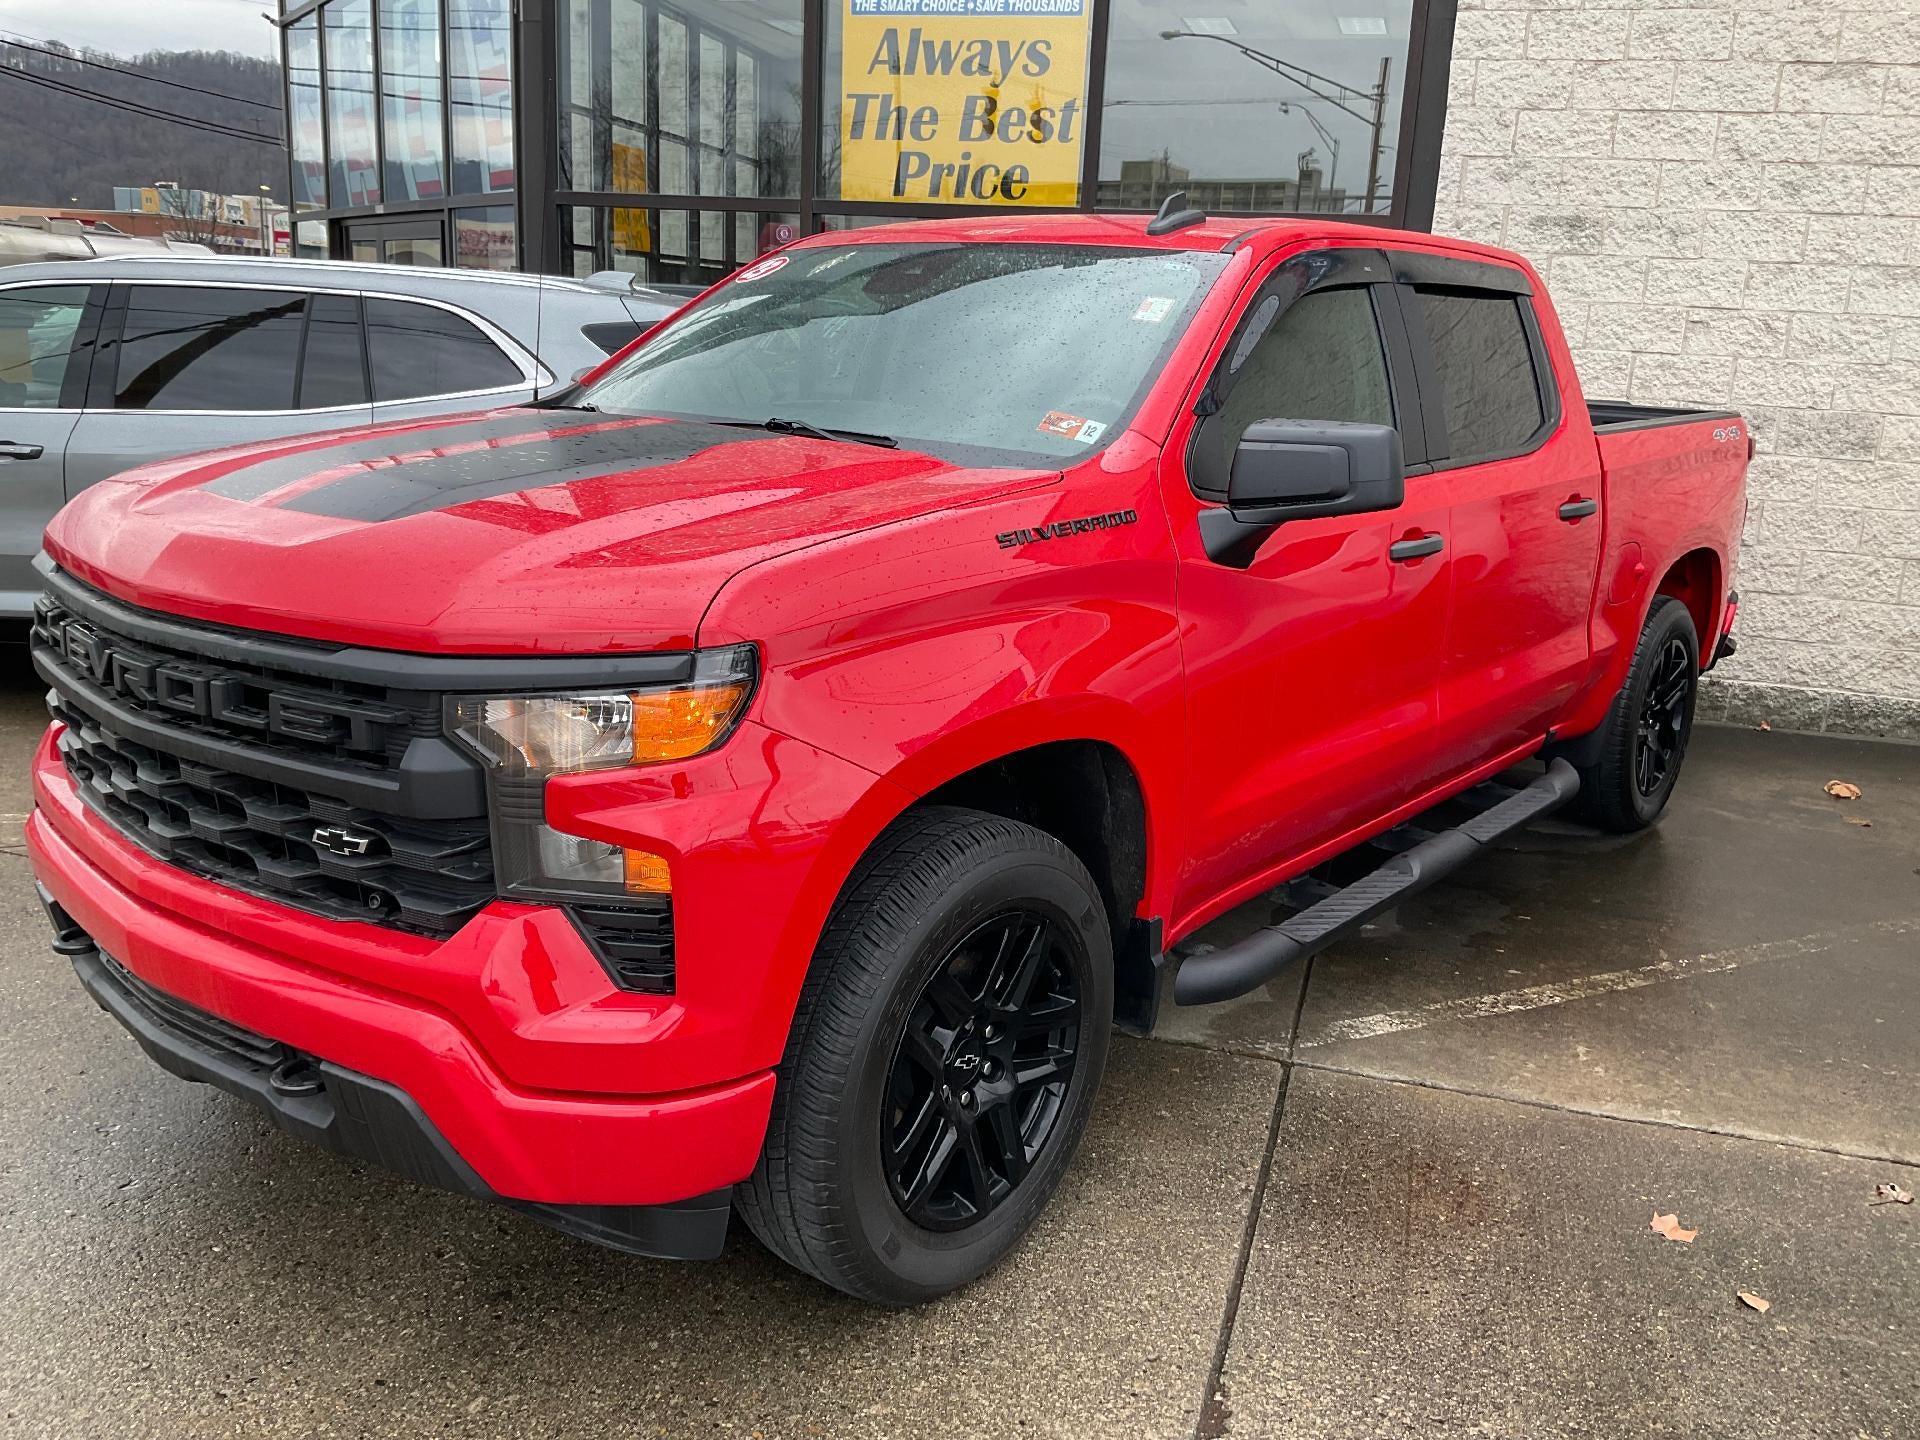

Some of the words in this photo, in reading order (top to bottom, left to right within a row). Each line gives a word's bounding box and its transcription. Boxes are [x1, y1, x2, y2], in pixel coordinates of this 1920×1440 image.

[856, 0, 876, 12] THE
[880, 0, 917, 12] SMART
[921, 0, 965, 12] CHOICE
[975, 0, 1005, 12] SAVE
[1008, 0, 1080, 12] THOUSANDS
[867, 27, 1052, 88] Always
[847, 93, 939, 142] The
[958, 95, 1079, 144] Best
[893, 151, 1030, 200] Price
[996, 509, 1137, 549] SILVERADO
